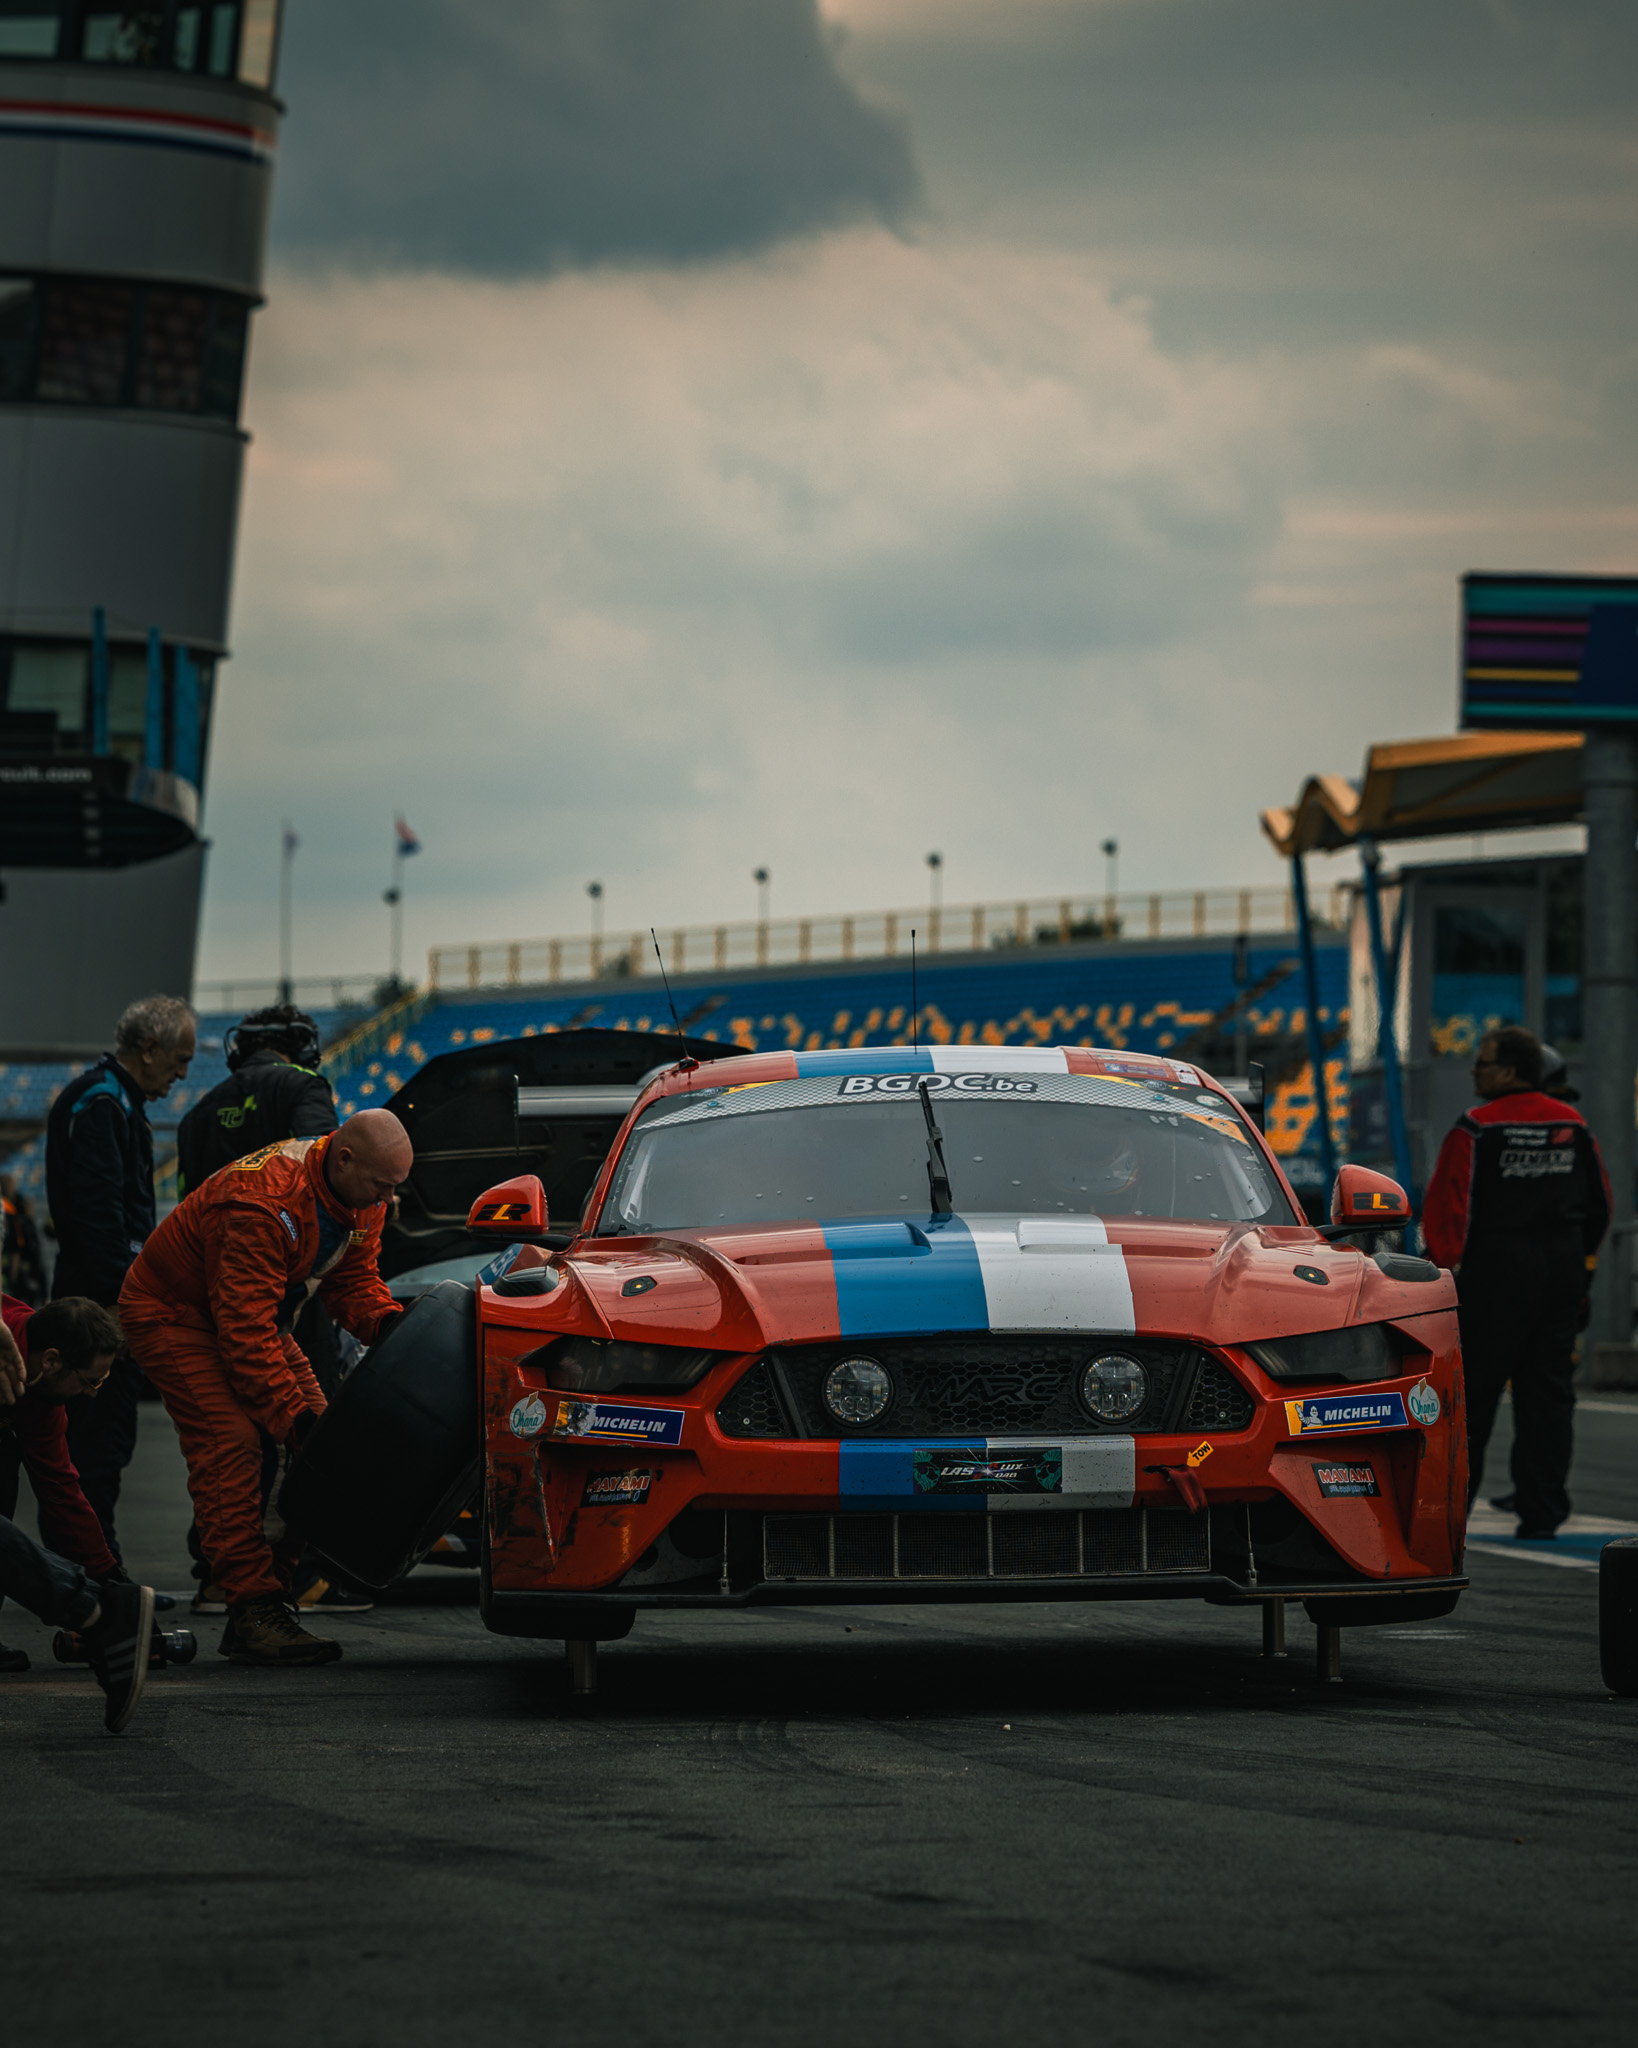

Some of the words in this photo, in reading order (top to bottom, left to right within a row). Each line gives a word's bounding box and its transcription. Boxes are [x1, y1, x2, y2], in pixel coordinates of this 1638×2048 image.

[842, 1074, 1034, 1094] BGDC.be
[513, 1408, 542, 1428] Ohana
[1324, 1405, 1391, 1421] MICHELIN
[593, 1416, 666, 1433] MICHELIN
[1192, 1443, 1211, 1461] TOW
[1318, 1468, 1374, 1484] MAYAMI
